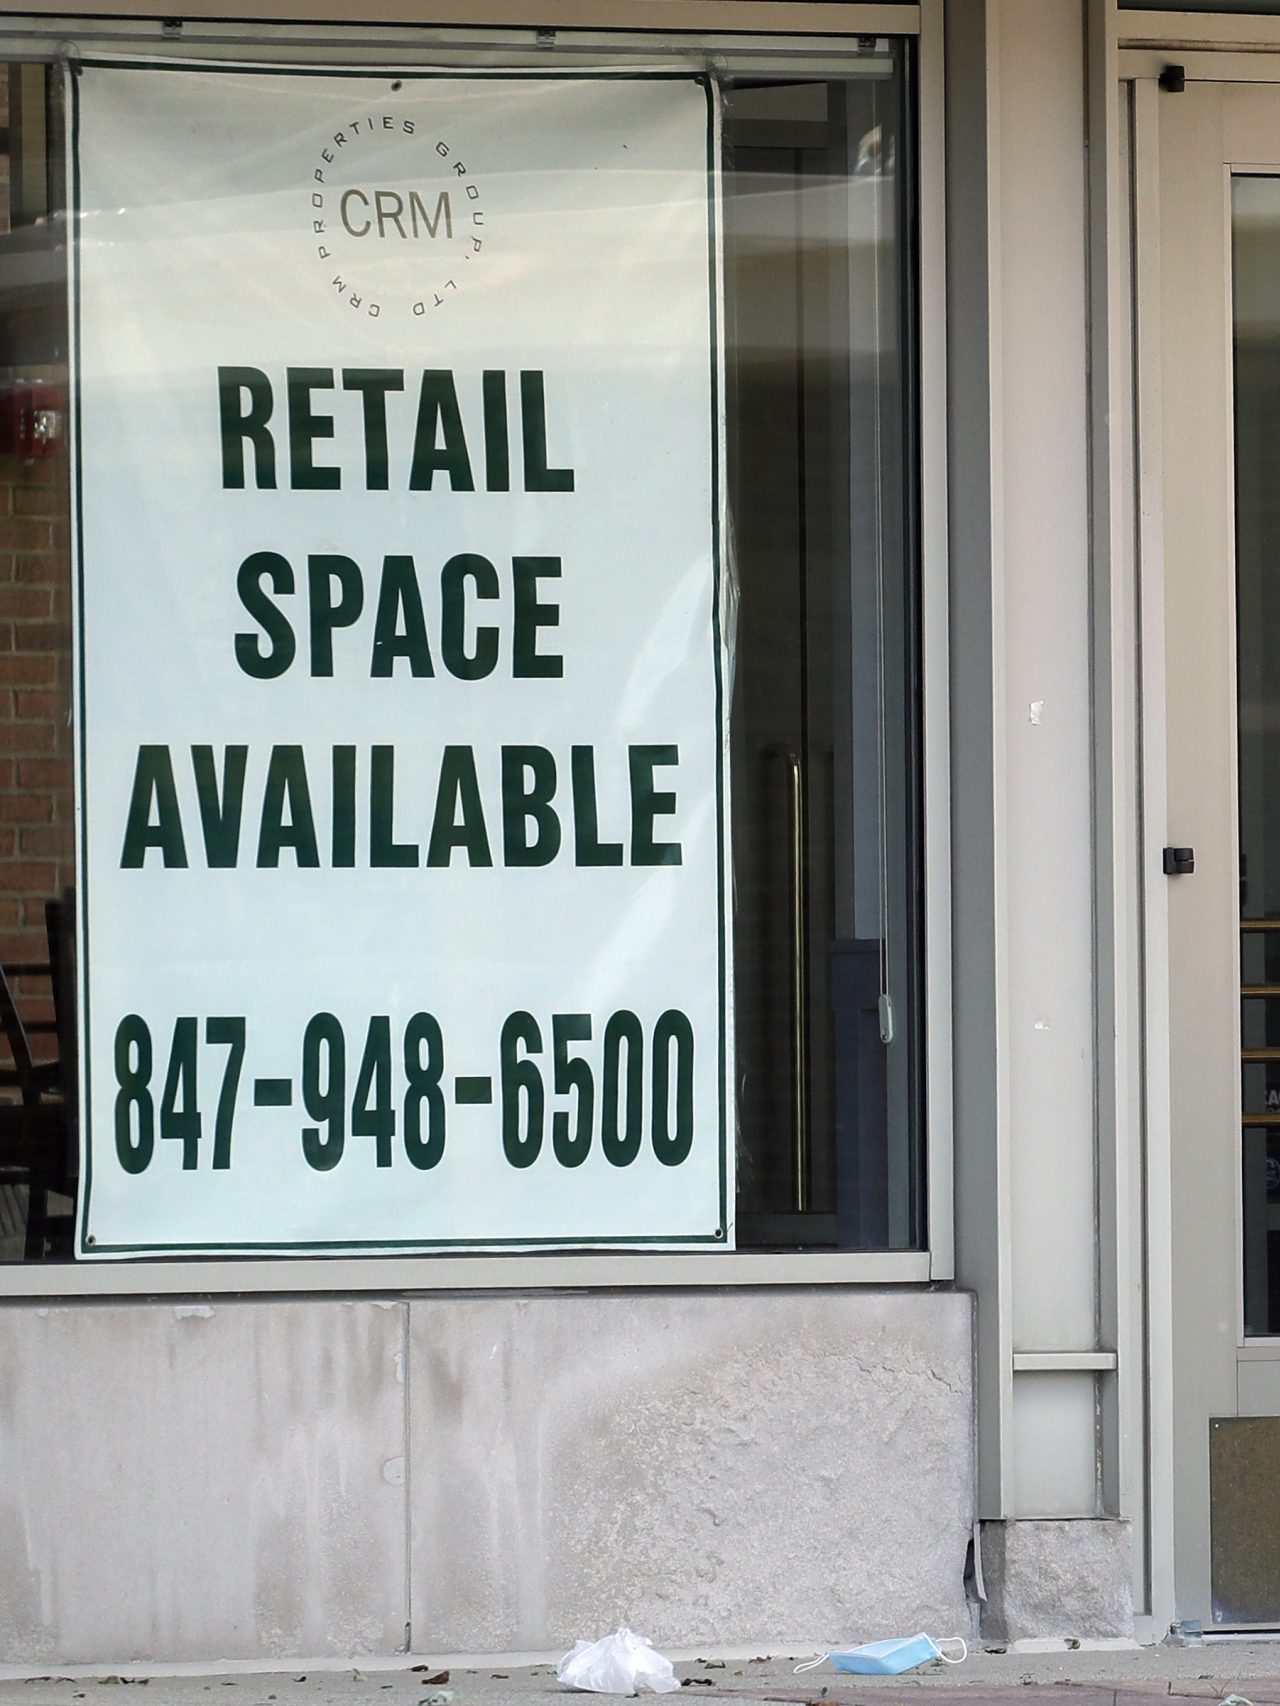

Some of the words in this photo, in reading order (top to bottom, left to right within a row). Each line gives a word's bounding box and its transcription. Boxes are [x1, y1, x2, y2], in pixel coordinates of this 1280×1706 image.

[312, 117, 415, 259] PROPERTIES
[340, 188, 453, 239] CRM
[332, 275, 380, 318] CRM
[412, 279, 457, 316] LTD
[217, 366, 575, 493] RETAIL
[234, 551, 564, 681] SPACE
[119, 744, 683, 869] AVAILABLE
[114, 1009, 694, 1175] 847-948-6500
